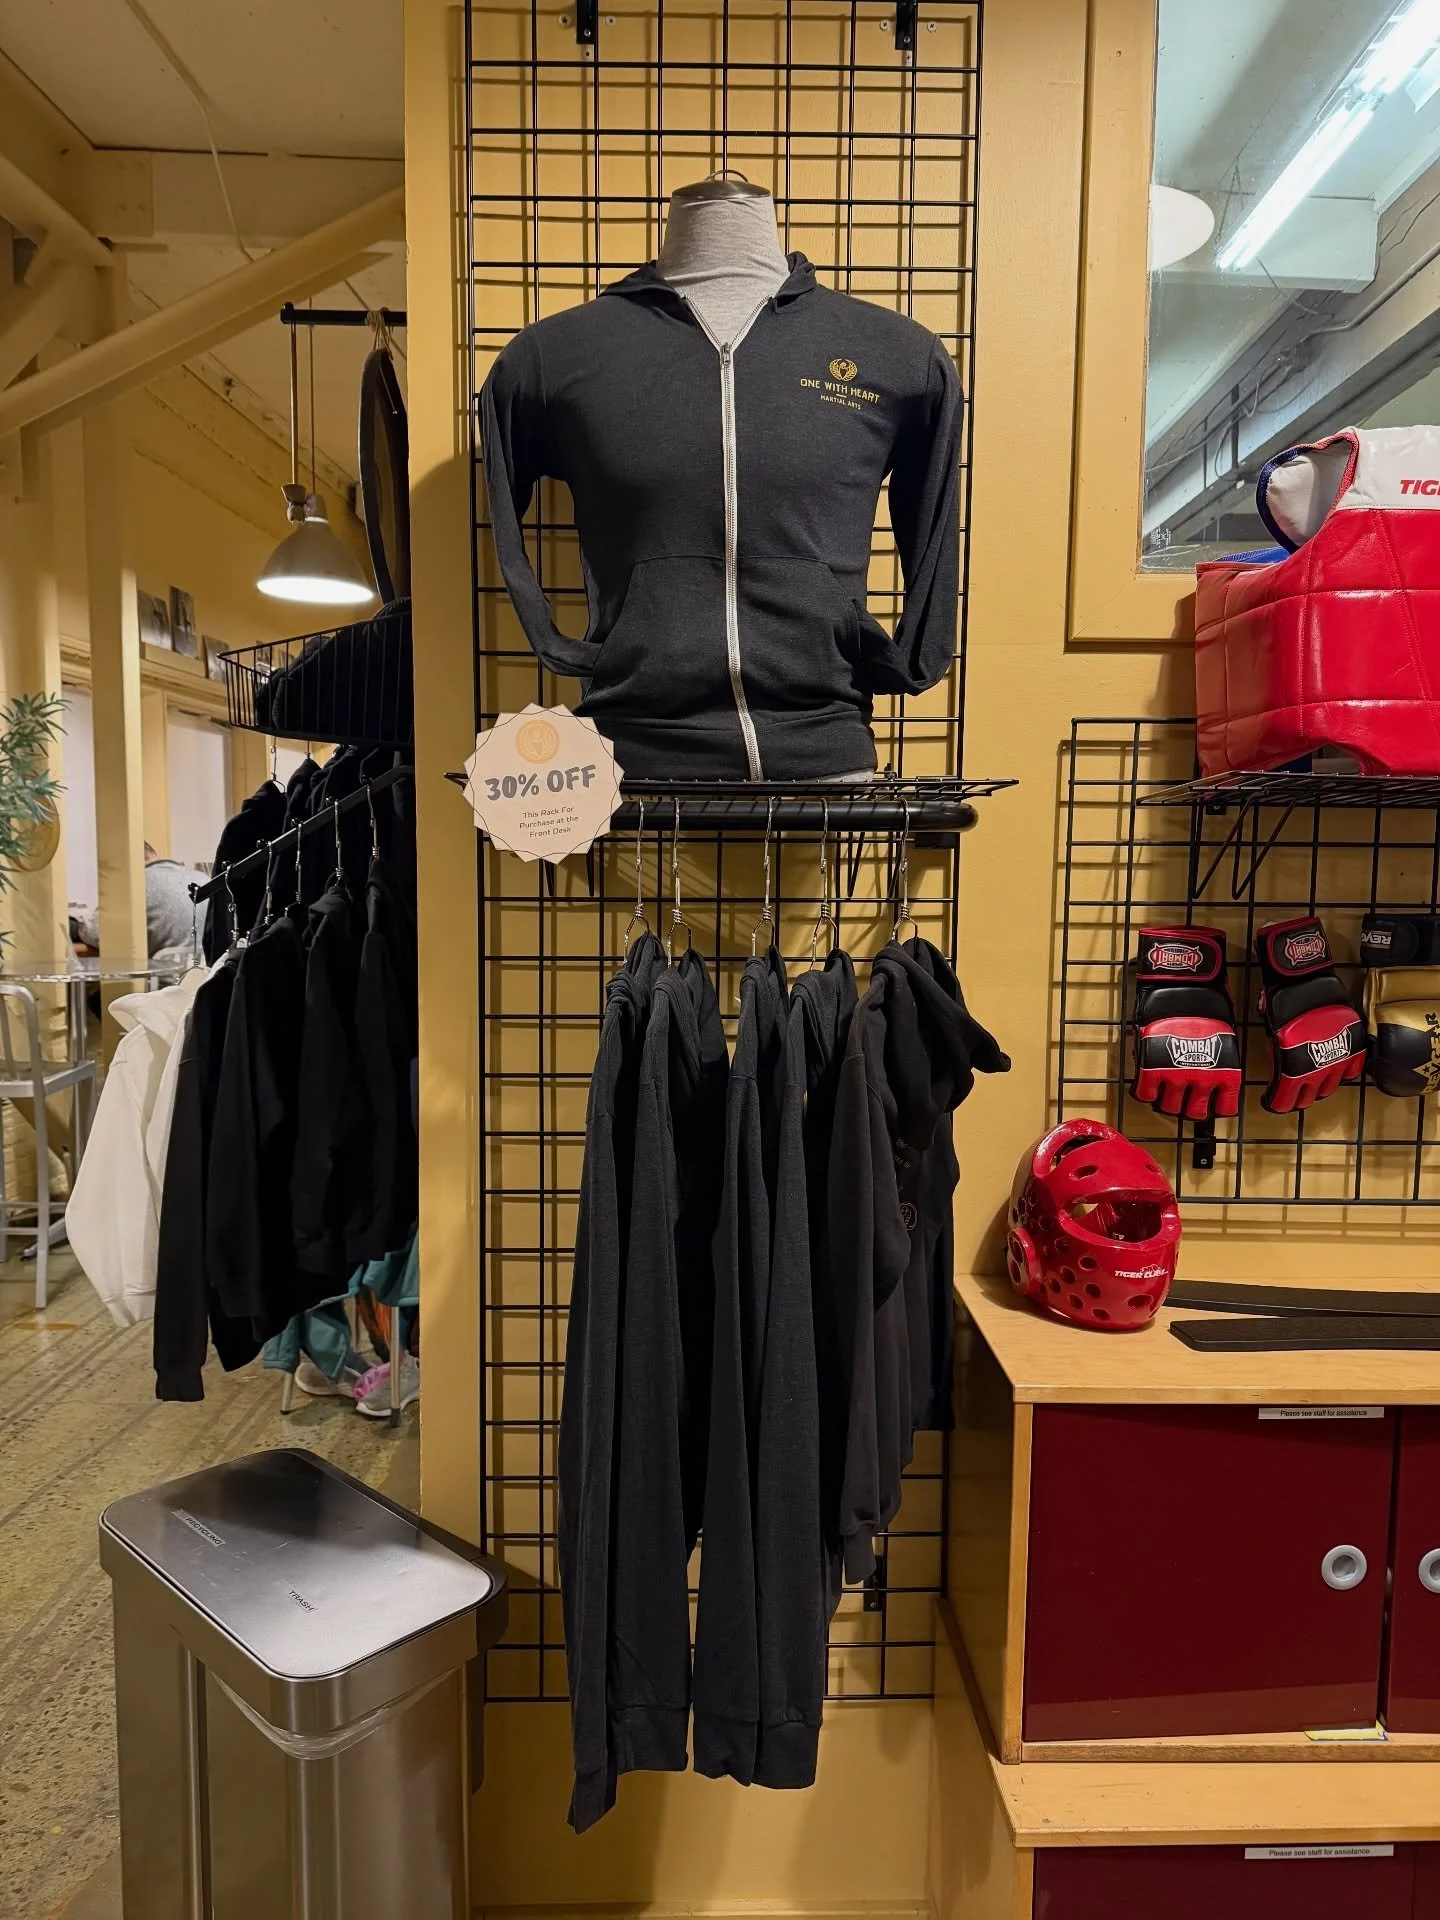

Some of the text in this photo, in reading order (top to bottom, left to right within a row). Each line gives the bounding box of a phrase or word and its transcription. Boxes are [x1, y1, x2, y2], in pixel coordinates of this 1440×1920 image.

[800, 378, 880, 404] ONE WITH HEART
[820, 394, 861, 410] MARTIAL ARTS
[1400, 479, 1440, 496] TIG
[485, 764, 597, 801] 30% OFF
[522, 806, 574, 819] This Rack For
[519, 820, 555, 829] Purchase
[566, 815, 579, 823] the
[529, 826, 572, 838] Front Desk
[1156, 950, 1194, 966] COMBAT
[1171, 1035, 1218, 1060] COMBAT
[1310, 1029, 1348, 1062] COMBAT
[1183, 1053, 1208, 1062] SPORTS
[1323, 1050, 1344, 1062] SPORTS
[1114, 1270, 1143, 1278] TIGER
[1313, 1409, 1327, 1417] staff
[185, 1516, 223, 1546] RECYCLING
[288, 1590, 314, 1611] TRASH
[1269, 1849, 1292, 1857] Please
[1307, 1848, 1323, 1856] staff
